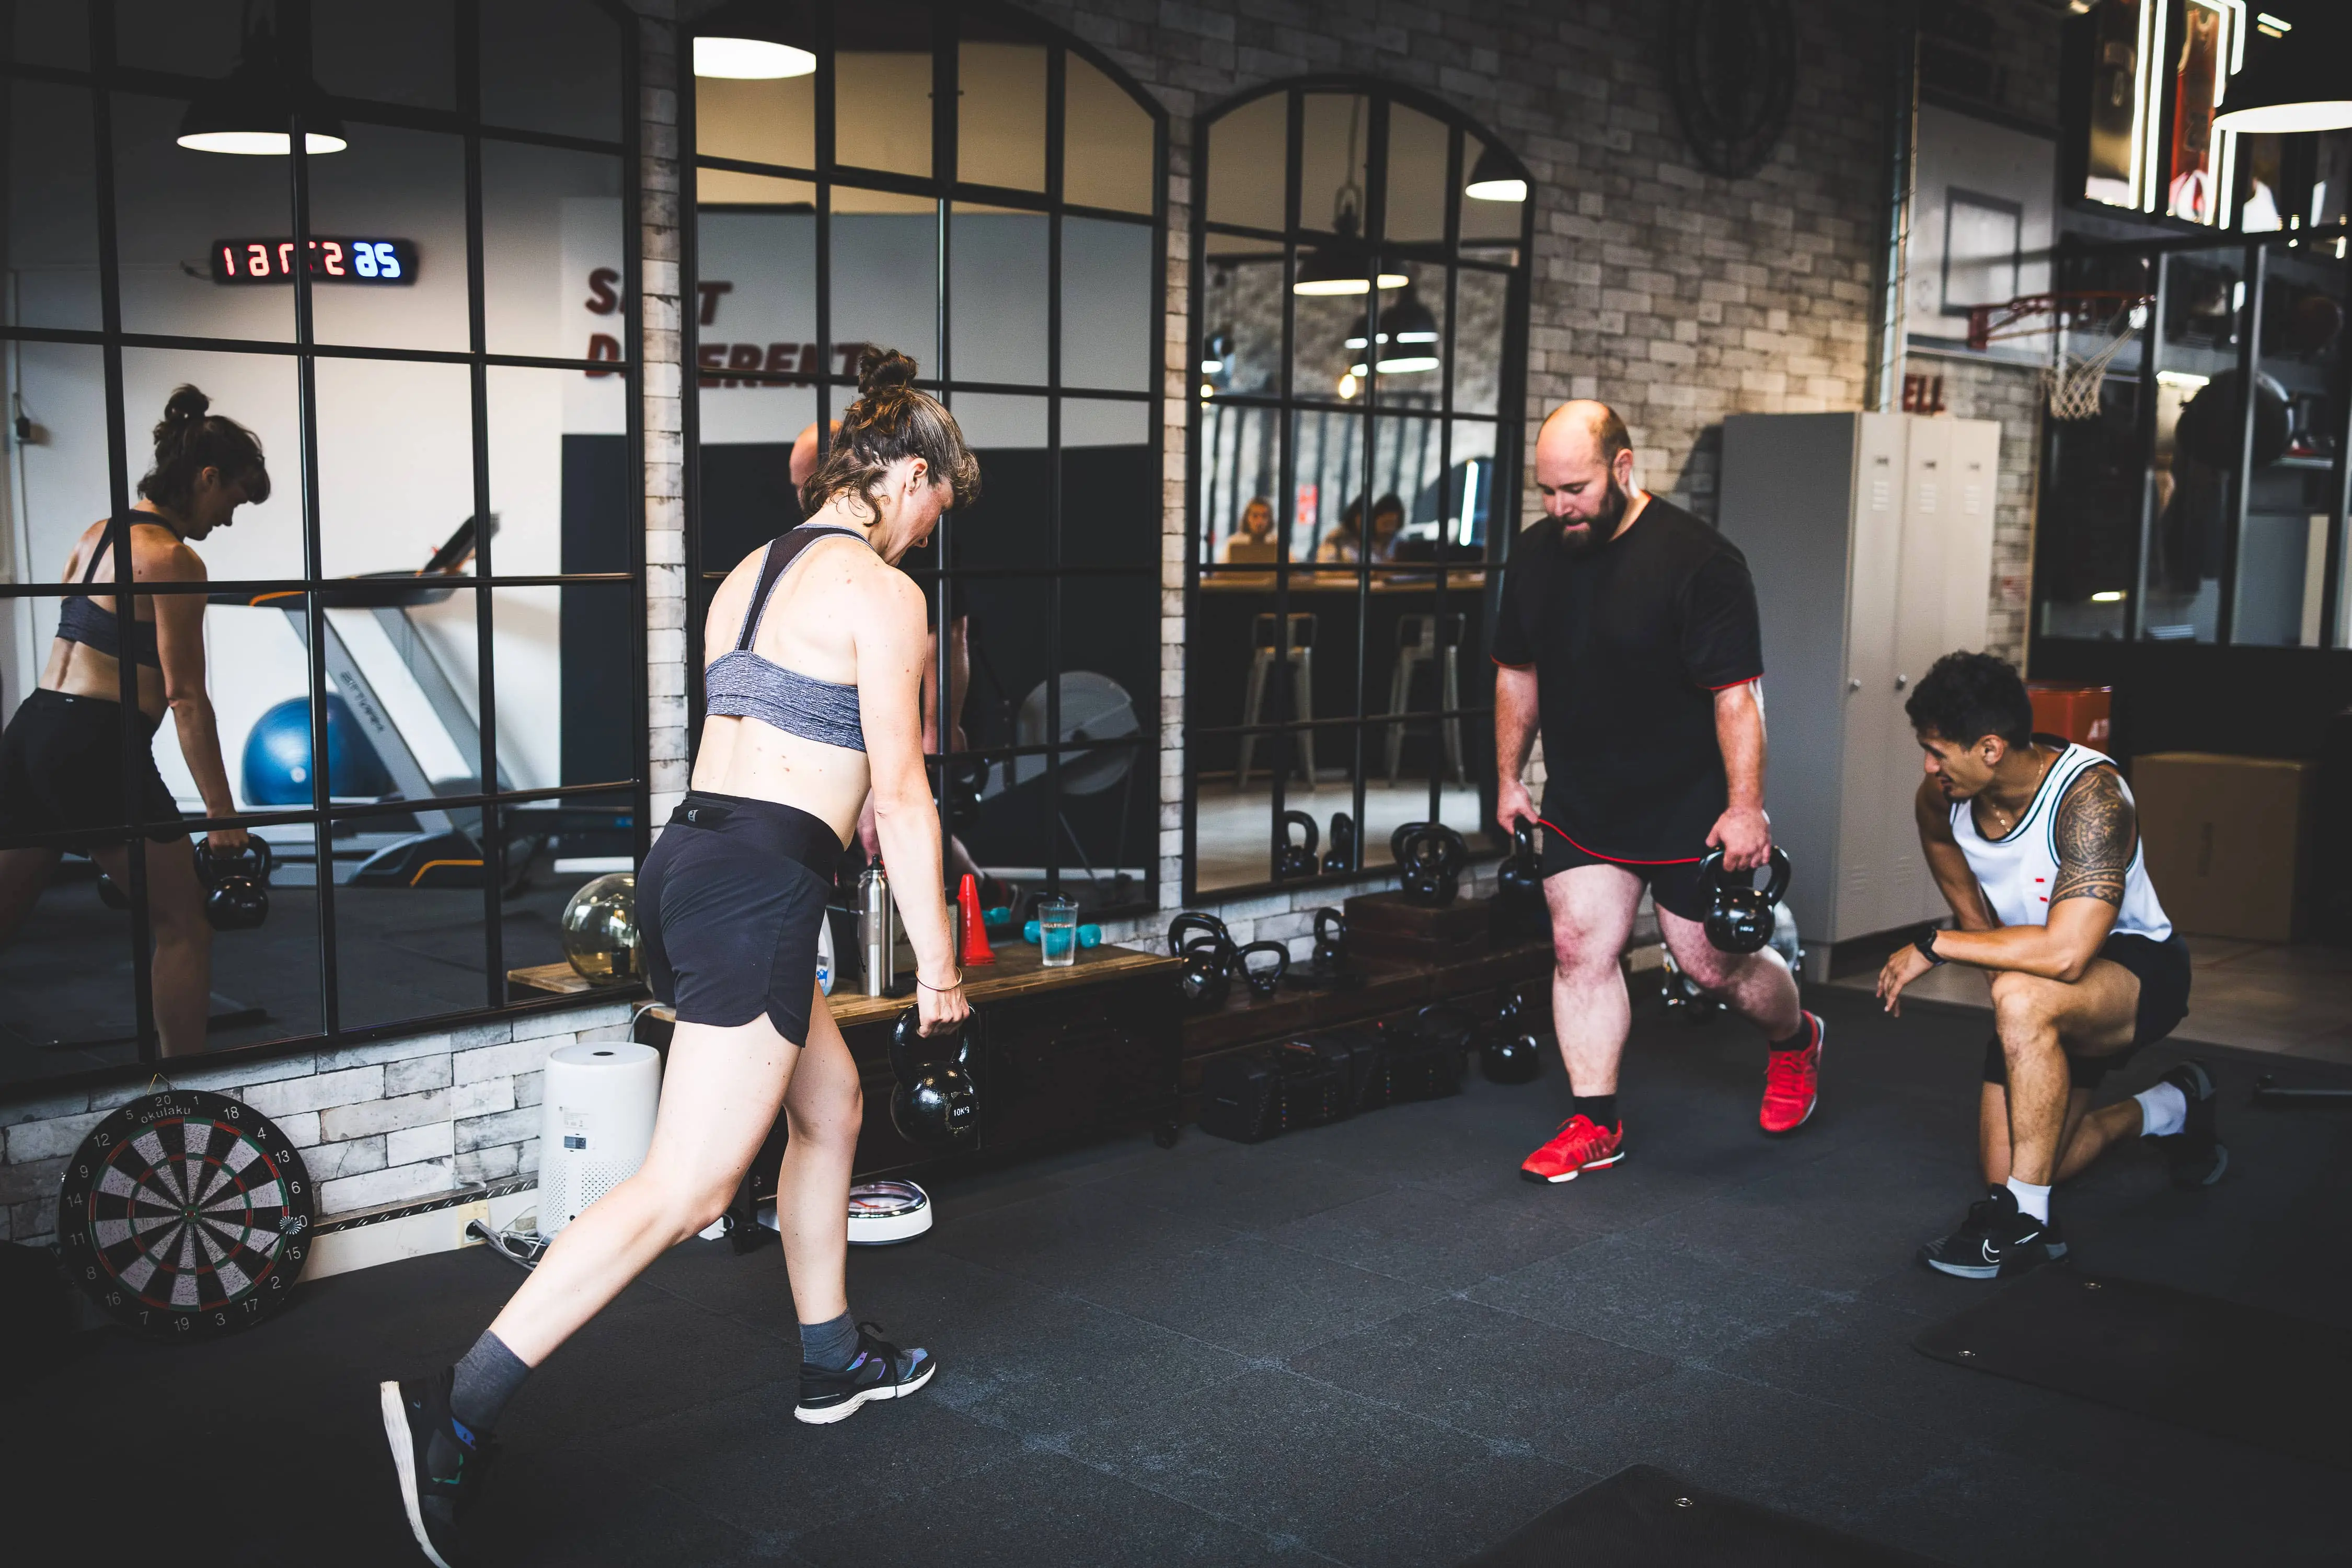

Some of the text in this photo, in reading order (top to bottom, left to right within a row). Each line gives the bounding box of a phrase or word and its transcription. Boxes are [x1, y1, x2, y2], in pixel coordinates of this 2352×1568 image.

[155, 1095, 171, 1106] 20
[193, 1096, 199, 1105] 1
[126, 1110, 133, 1120] 5
[141, 1105, 190, 1123] okulaku
[224, 1106, 239, 1119] 18
[953, 1106, 970, 1116] 10KG
[258, 1127, 266, 1139] 4
[93, 1134, 111, 1147] 12
[276, 1150, 290, 1163] 13
[80, 1166, 88, 1178] 9
[292, 1182, 300, 1193] 6
[67, 1193, 83, 1207] 14
[71, 1232, 85, 1245] 11
[286, 1247, 301, 1260] 15
[86, 1266, 96, 1279] 8
[271, 1276, 281, 1289] 2
[106, 1292, 121, 1306] 16
[243, 1299, 257, 1312] 17
[140, 1311, 148, 1324] 7
[215, 1313, 225, 1325] 3
[175, 1318, 189, 1331] 19
